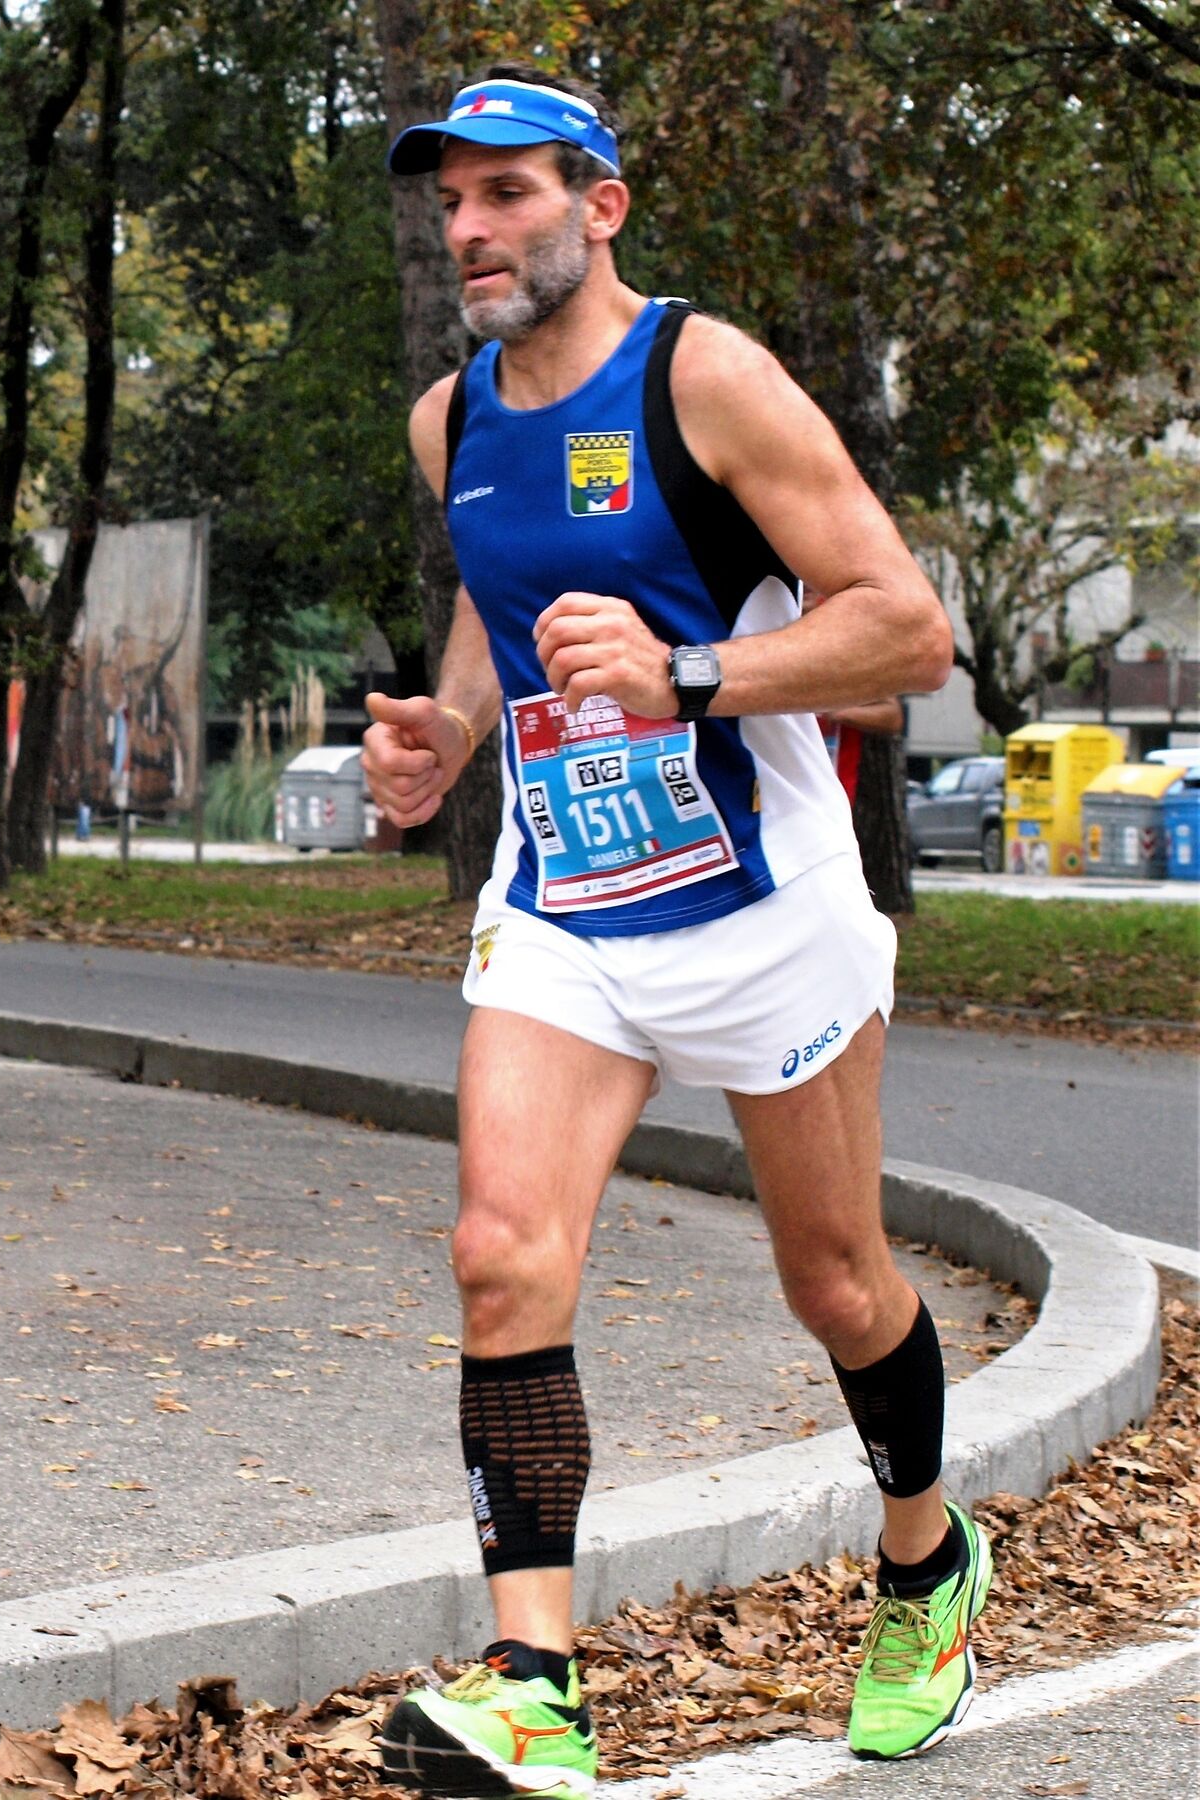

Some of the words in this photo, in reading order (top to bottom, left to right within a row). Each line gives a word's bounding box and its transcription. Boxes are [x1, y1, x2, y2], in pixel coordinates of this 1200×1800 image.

[567, 789, 654, 848] 1511
[587, 845, 639, 868] DANIELE
[803, 1020, 842, 1062] asics
[466, 1466, 492, 1521] BIONIC
